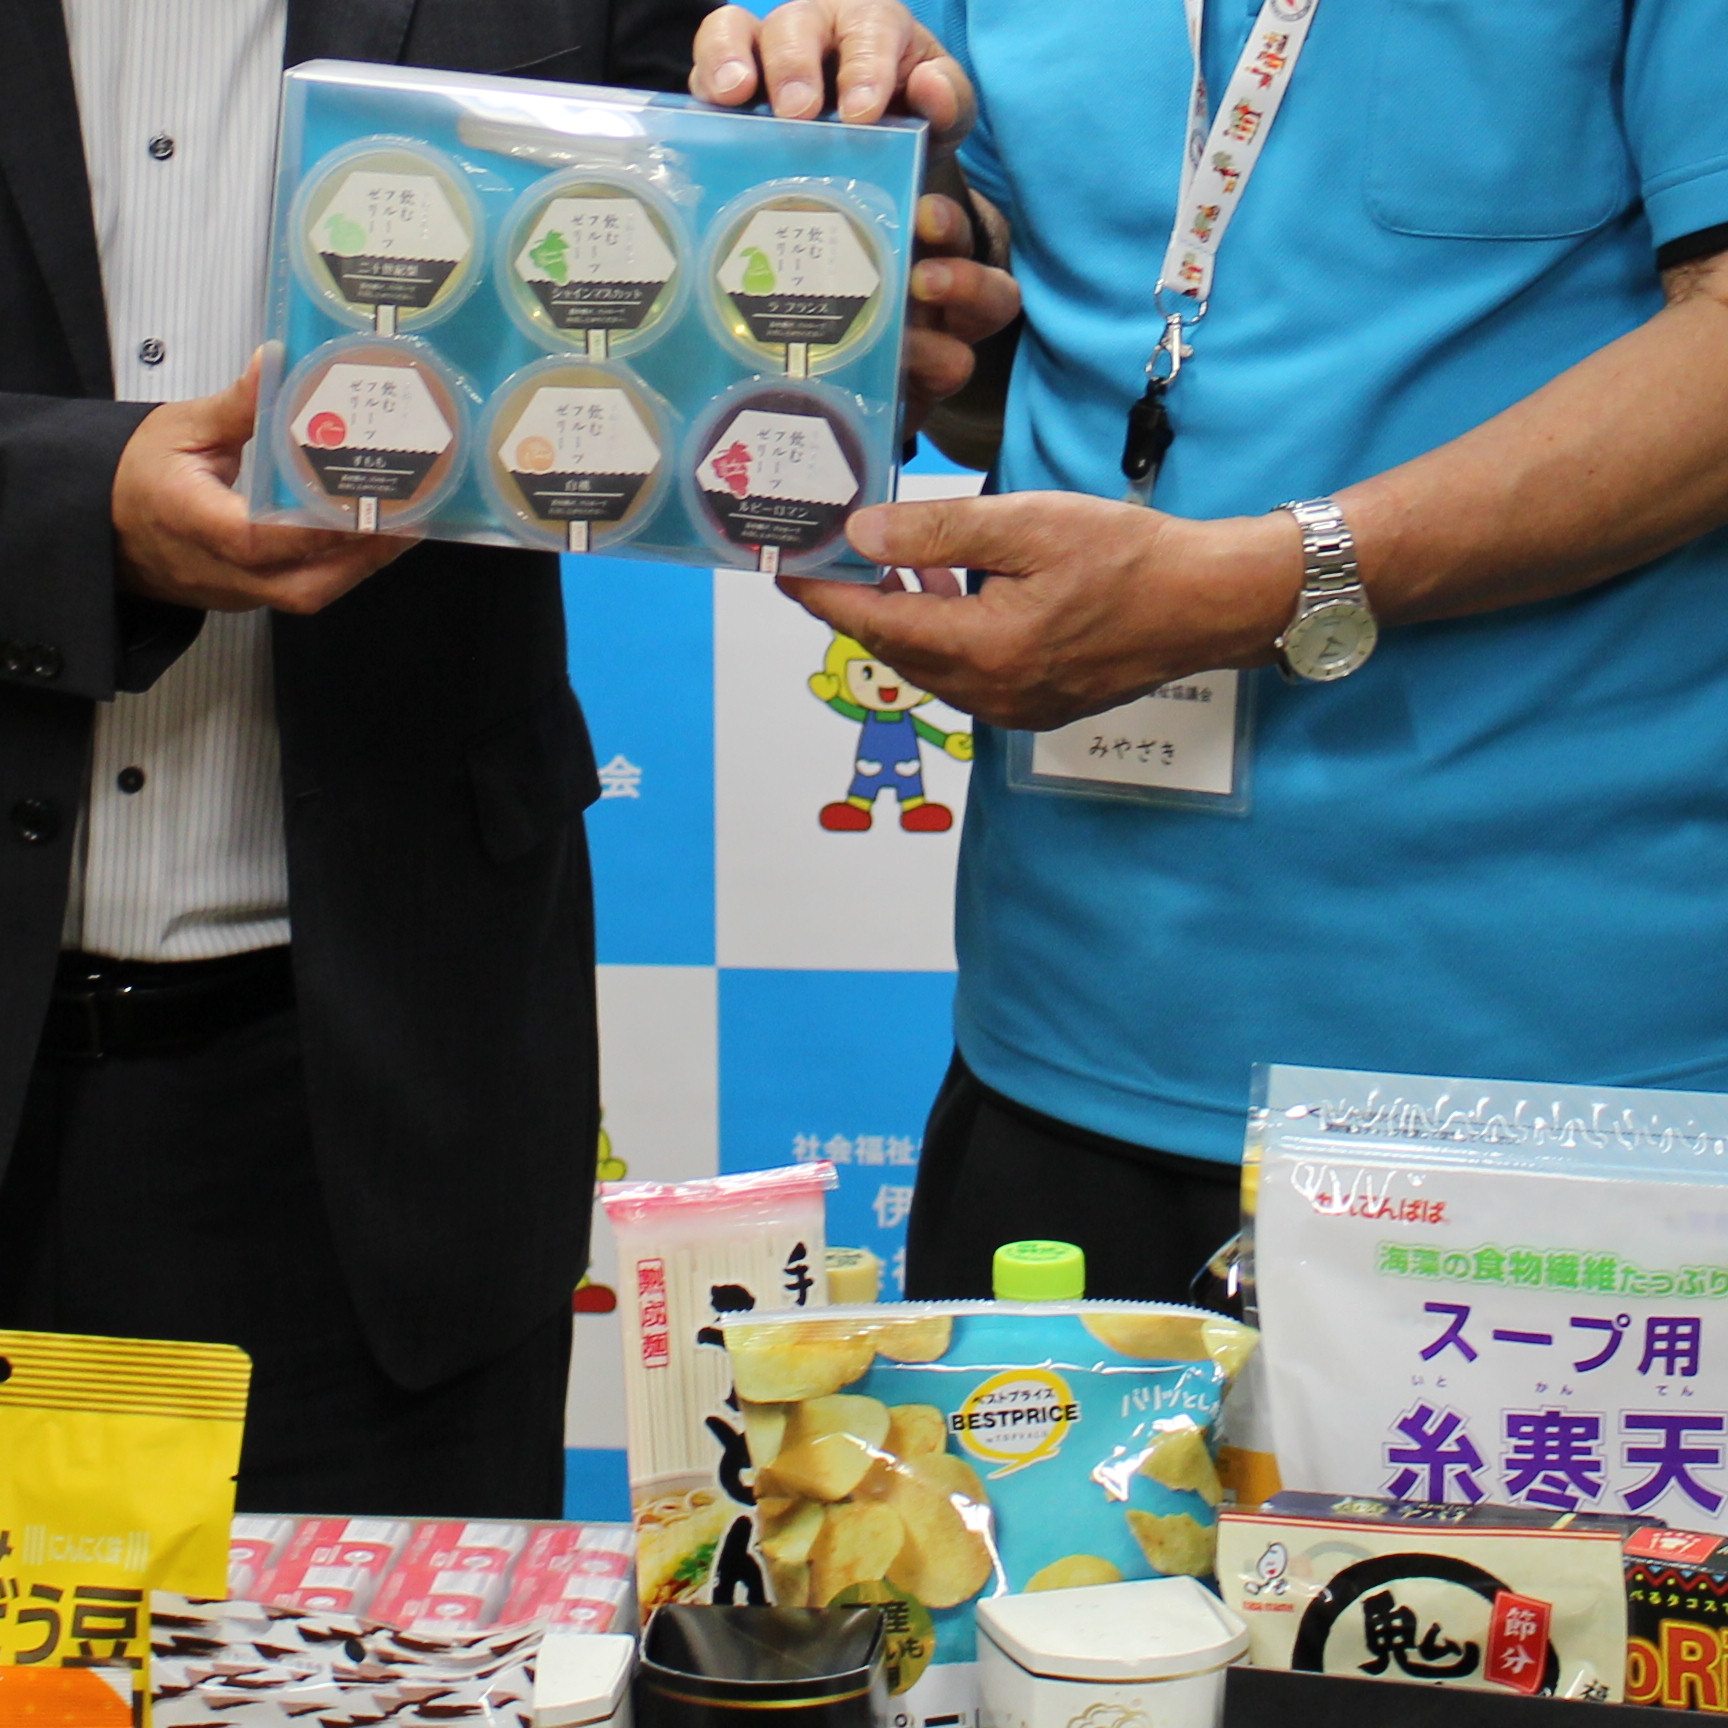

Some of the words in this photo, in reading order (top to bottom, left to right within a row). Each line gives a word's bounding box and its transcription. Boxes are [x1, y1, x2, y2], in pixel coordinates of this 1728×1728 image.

[792, 1133, 920, 1165] 社会福祉
[1418, 1301, 1703, 1378] スープ用
[952, 1403, 1078, 1431] BESTPRICE
[1384, 1400, 1726, 1516] 糸寒天
[1358, 1589, 1479, 1679] 鬼
[1502, 1606, 1538, 1674] 節分
